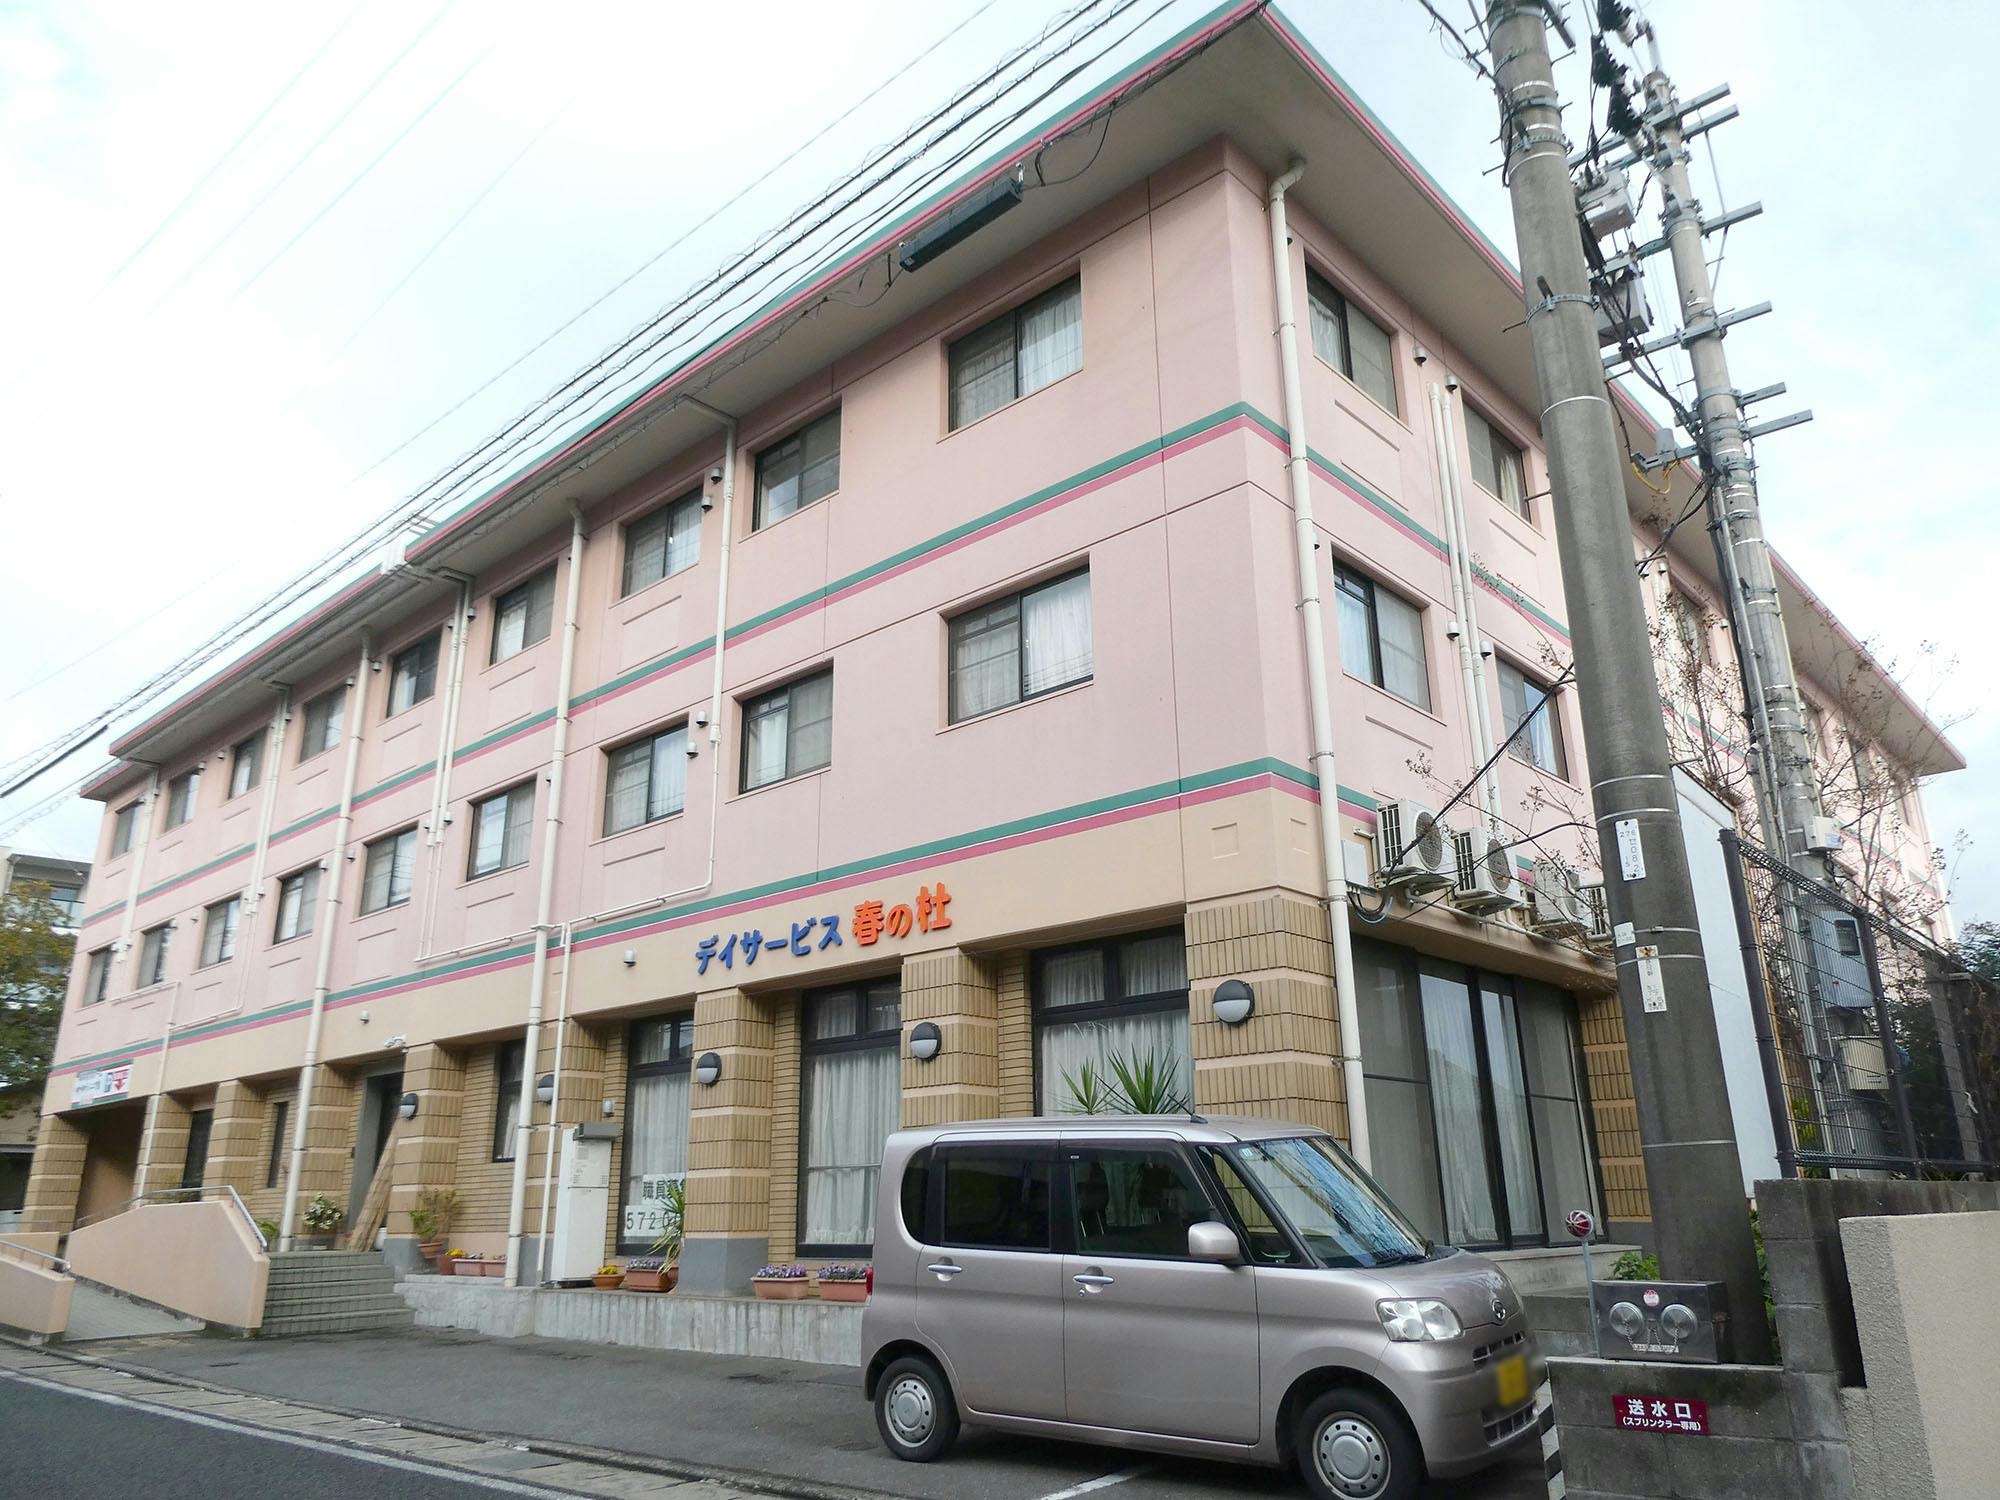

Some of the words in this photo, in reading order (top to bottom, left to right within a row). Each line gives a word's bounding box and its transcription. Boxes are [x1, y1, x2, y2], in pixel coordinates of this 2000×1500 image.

[696, 914, 843, 976] デイサービス
[852, 881, 953, 946] 春の杜
[626, 1209, 681, 1231] 5720
[1627, 1398, 1692, 1419] 送水口
